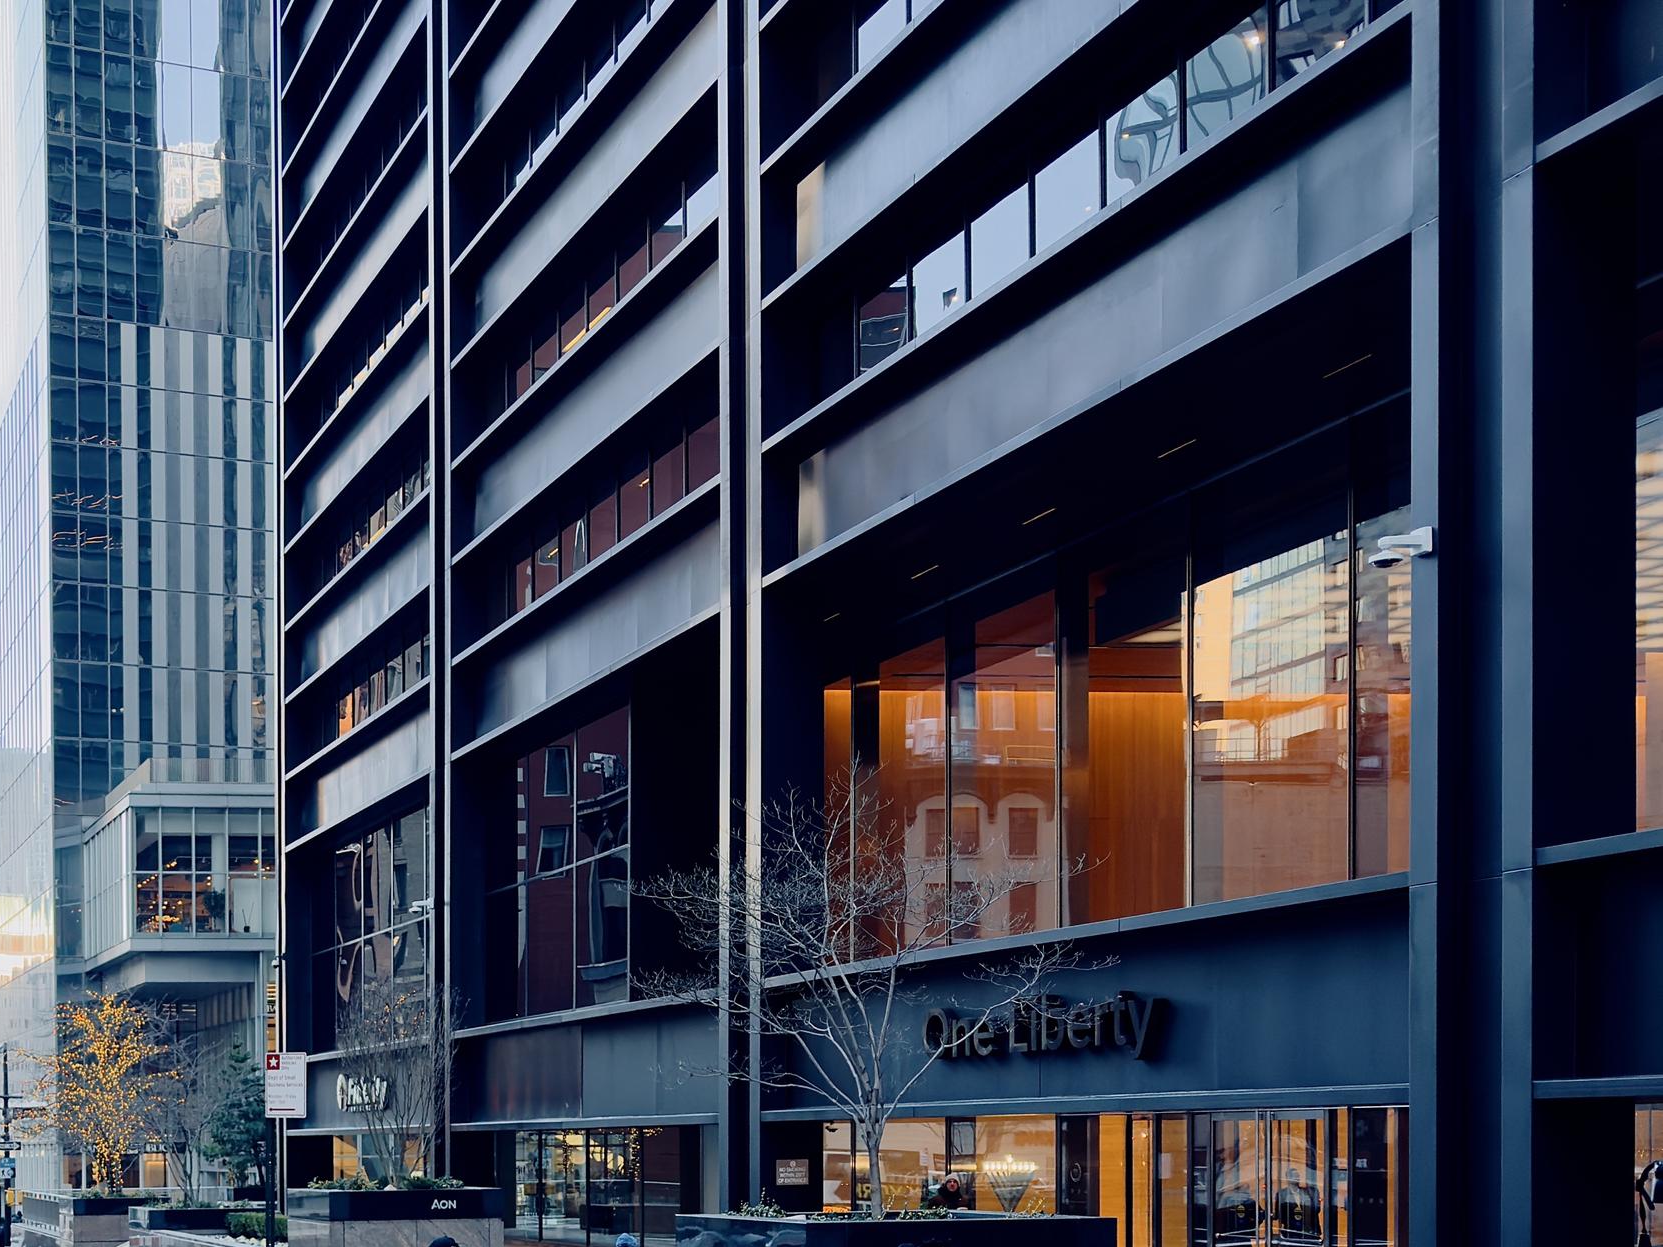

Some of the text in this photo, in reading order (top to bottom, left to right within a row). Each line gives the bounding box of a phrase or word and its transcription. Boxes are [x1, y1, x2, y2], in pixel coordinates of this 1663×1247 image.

[922, 994, 1155, 1060] One Liberty
[431, 1199, 457, 1210] AON
